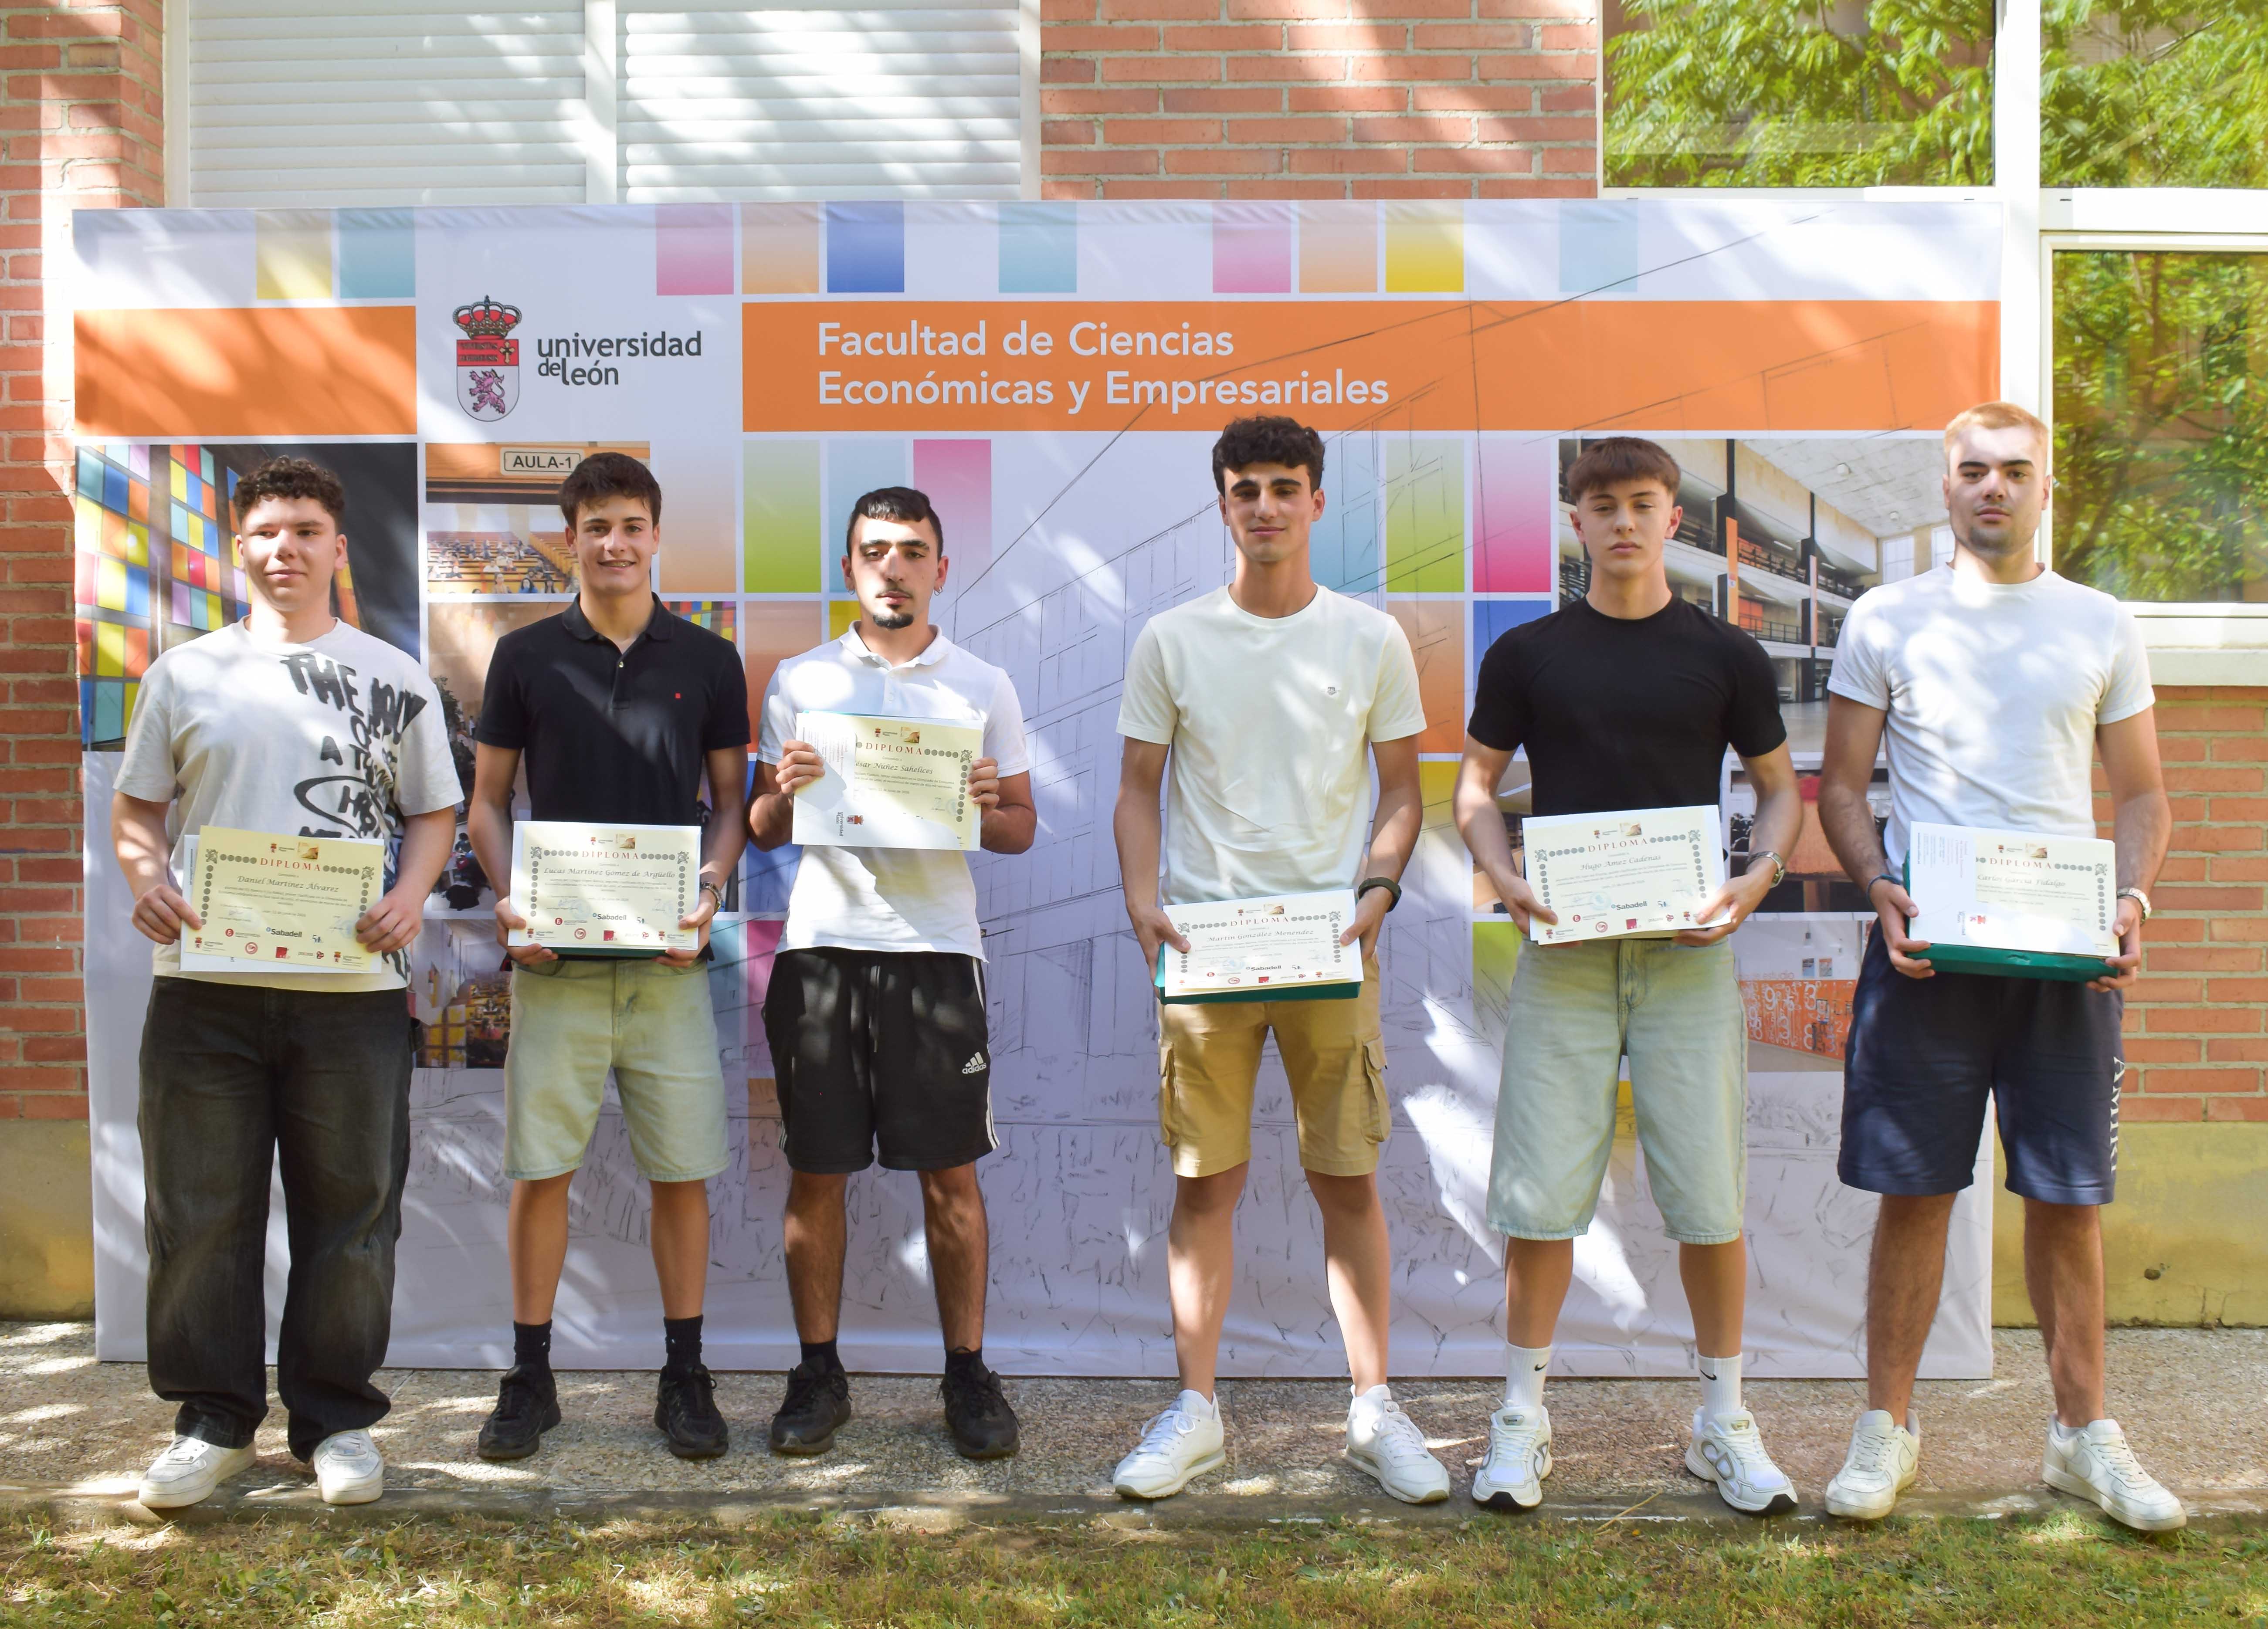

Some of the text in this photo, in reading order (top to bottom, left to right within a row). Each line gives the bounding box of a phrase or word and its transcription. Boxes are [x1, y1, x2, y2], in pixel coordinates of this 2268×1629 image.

[819, 320, 1234, 356] Facultad de Ciencias
[538, 331, 701, 357] universidad
[819, 368, 1389, 414] Económicas y Empresariales
[513, 455, 572, 469] AULA-1
[866, 742, 922, 755] DIPLOMA
[900, 765, 933, 774] Sahelices
[1588, 838, 1648, 852] DIPLOMA
[582, 851, 638, 860] DIPLOMA
[1629, 854, 1661, 864] Cadenas
[261, 858, 321, 871] DIPLOMA
[1990, 857, 2051, 869] DIPLOMA
[237, 876, 267, 884] Daniel
[1617, 901, 1647, 910] Sabadell
[1231, 917, 1288, 927] DIPLOMA
[271, 928, 302, 938] Sabadell
[962, 1063, 987, 1074] adidas
